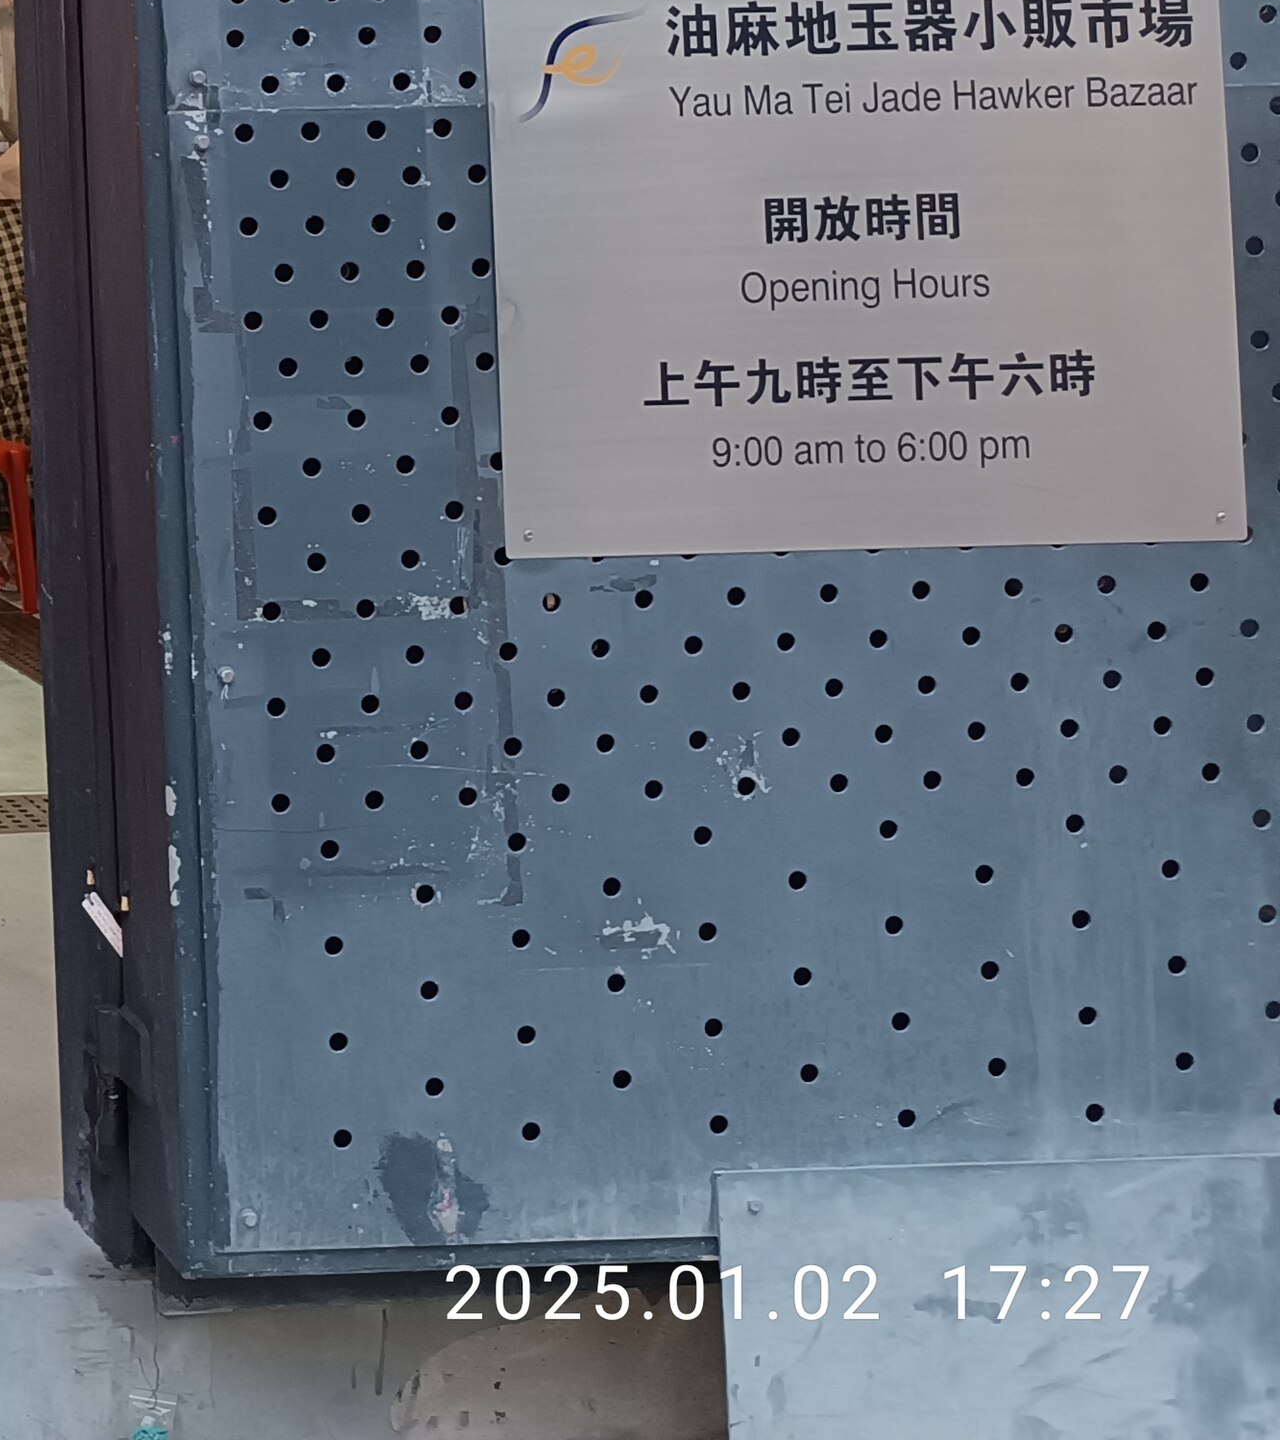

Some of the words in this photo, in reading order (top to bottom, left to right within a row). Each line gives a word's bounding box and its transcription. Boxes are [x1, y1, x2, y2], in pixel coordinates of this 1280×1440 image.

[670, 87, 730, 117] Yau
[745, 85, 793, 115] Ma
[803, 83, 851, 113] Tei
[863, 81, 940, 112] Jade
[953, 78, 1074, 109] Hawker
[1087, 76, 1198, 106] Bazaar
[764, 192, 961, 245] 開放時間
[740, 271, 880, 310] Opening
[893, 268, 990, 299] Hours
[643, 349, 1096, 408] 上午九時至下午六時
[712, 436, 783, 468] 9:00
[794, 440, 844, 465] am
[855, 434, 886, 463] to
[897, 431, 968, 462] 6:00
[980, 436, 1031, 469] pm
